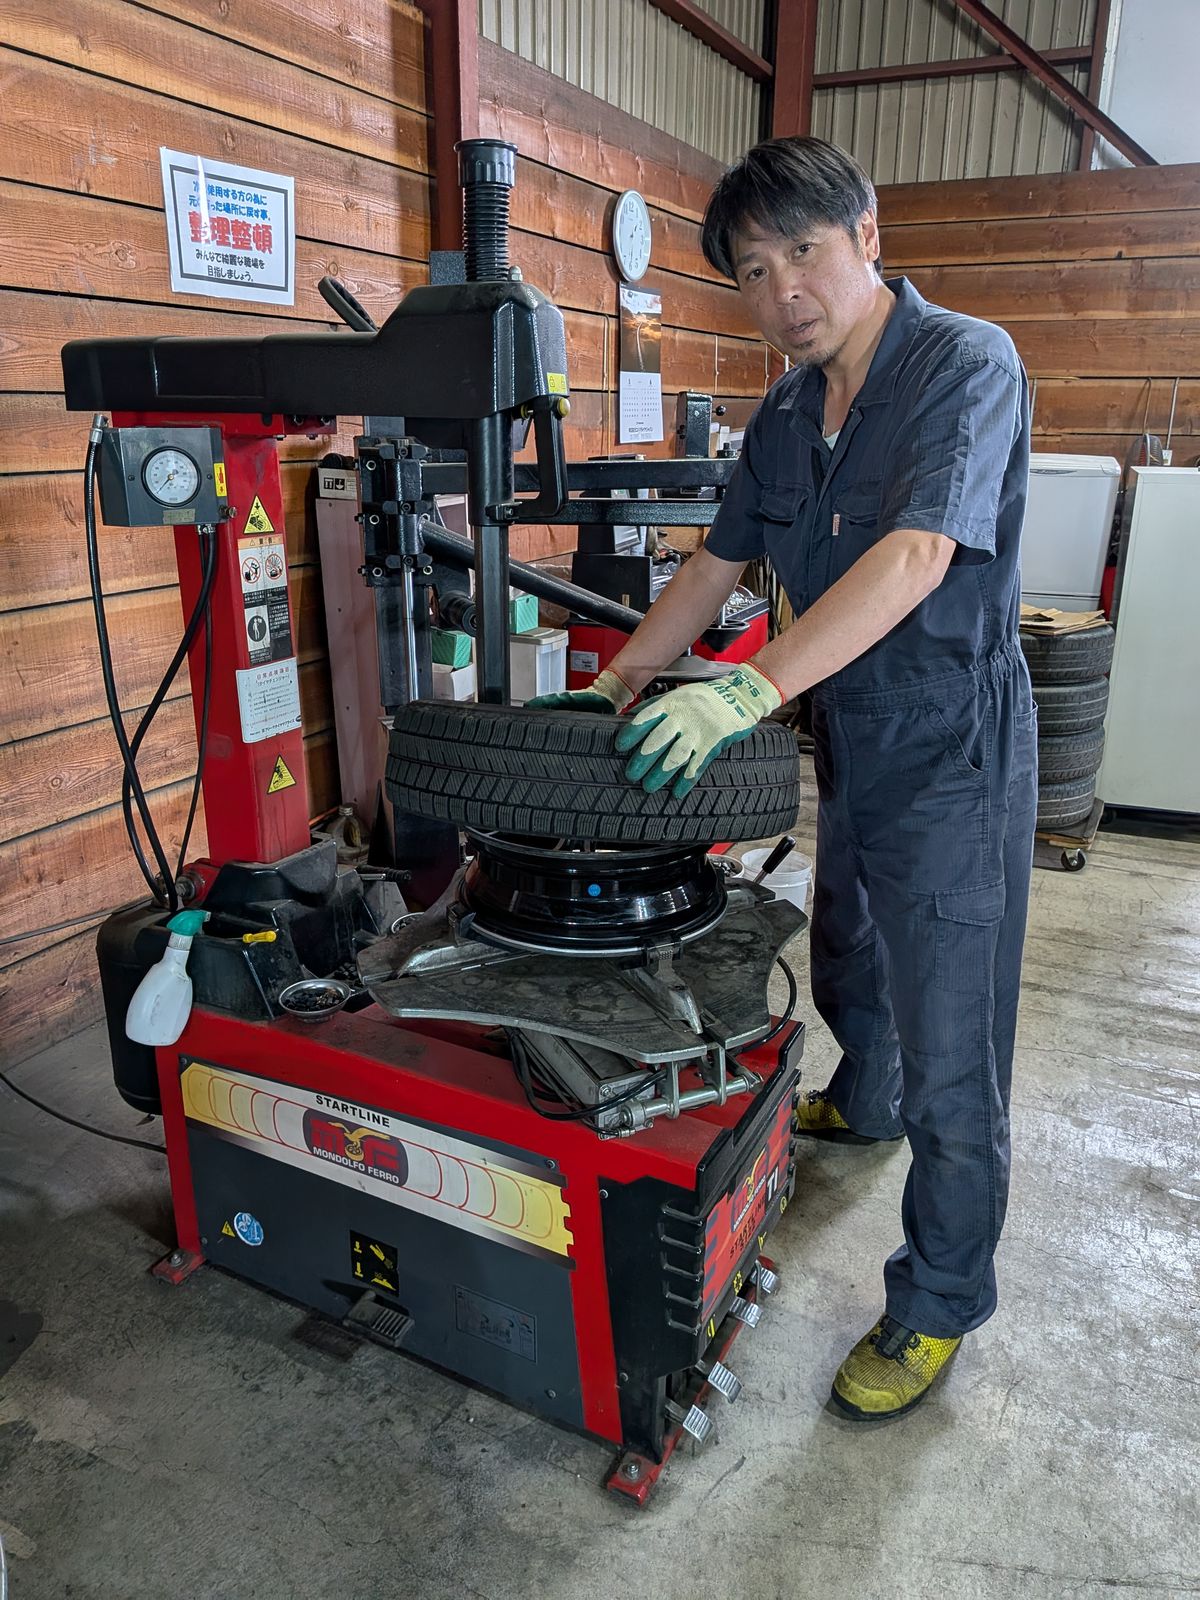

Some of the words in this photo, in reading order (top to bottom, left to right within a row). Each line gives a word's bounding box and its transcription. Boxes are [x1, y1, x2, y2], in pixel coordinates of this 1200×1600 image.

[188, 210, 273, 255] 整理整頓
[195, 249, 265, 270] みんなで綺麗な職場を
[207, 265, 254, 282] 目指しましょう。
[315, 1094, 390, 1128] STARTLINE
[313, 1146, 366, 1172] MONDOLFO
[368, 1165, 400, 1184] FERRO
